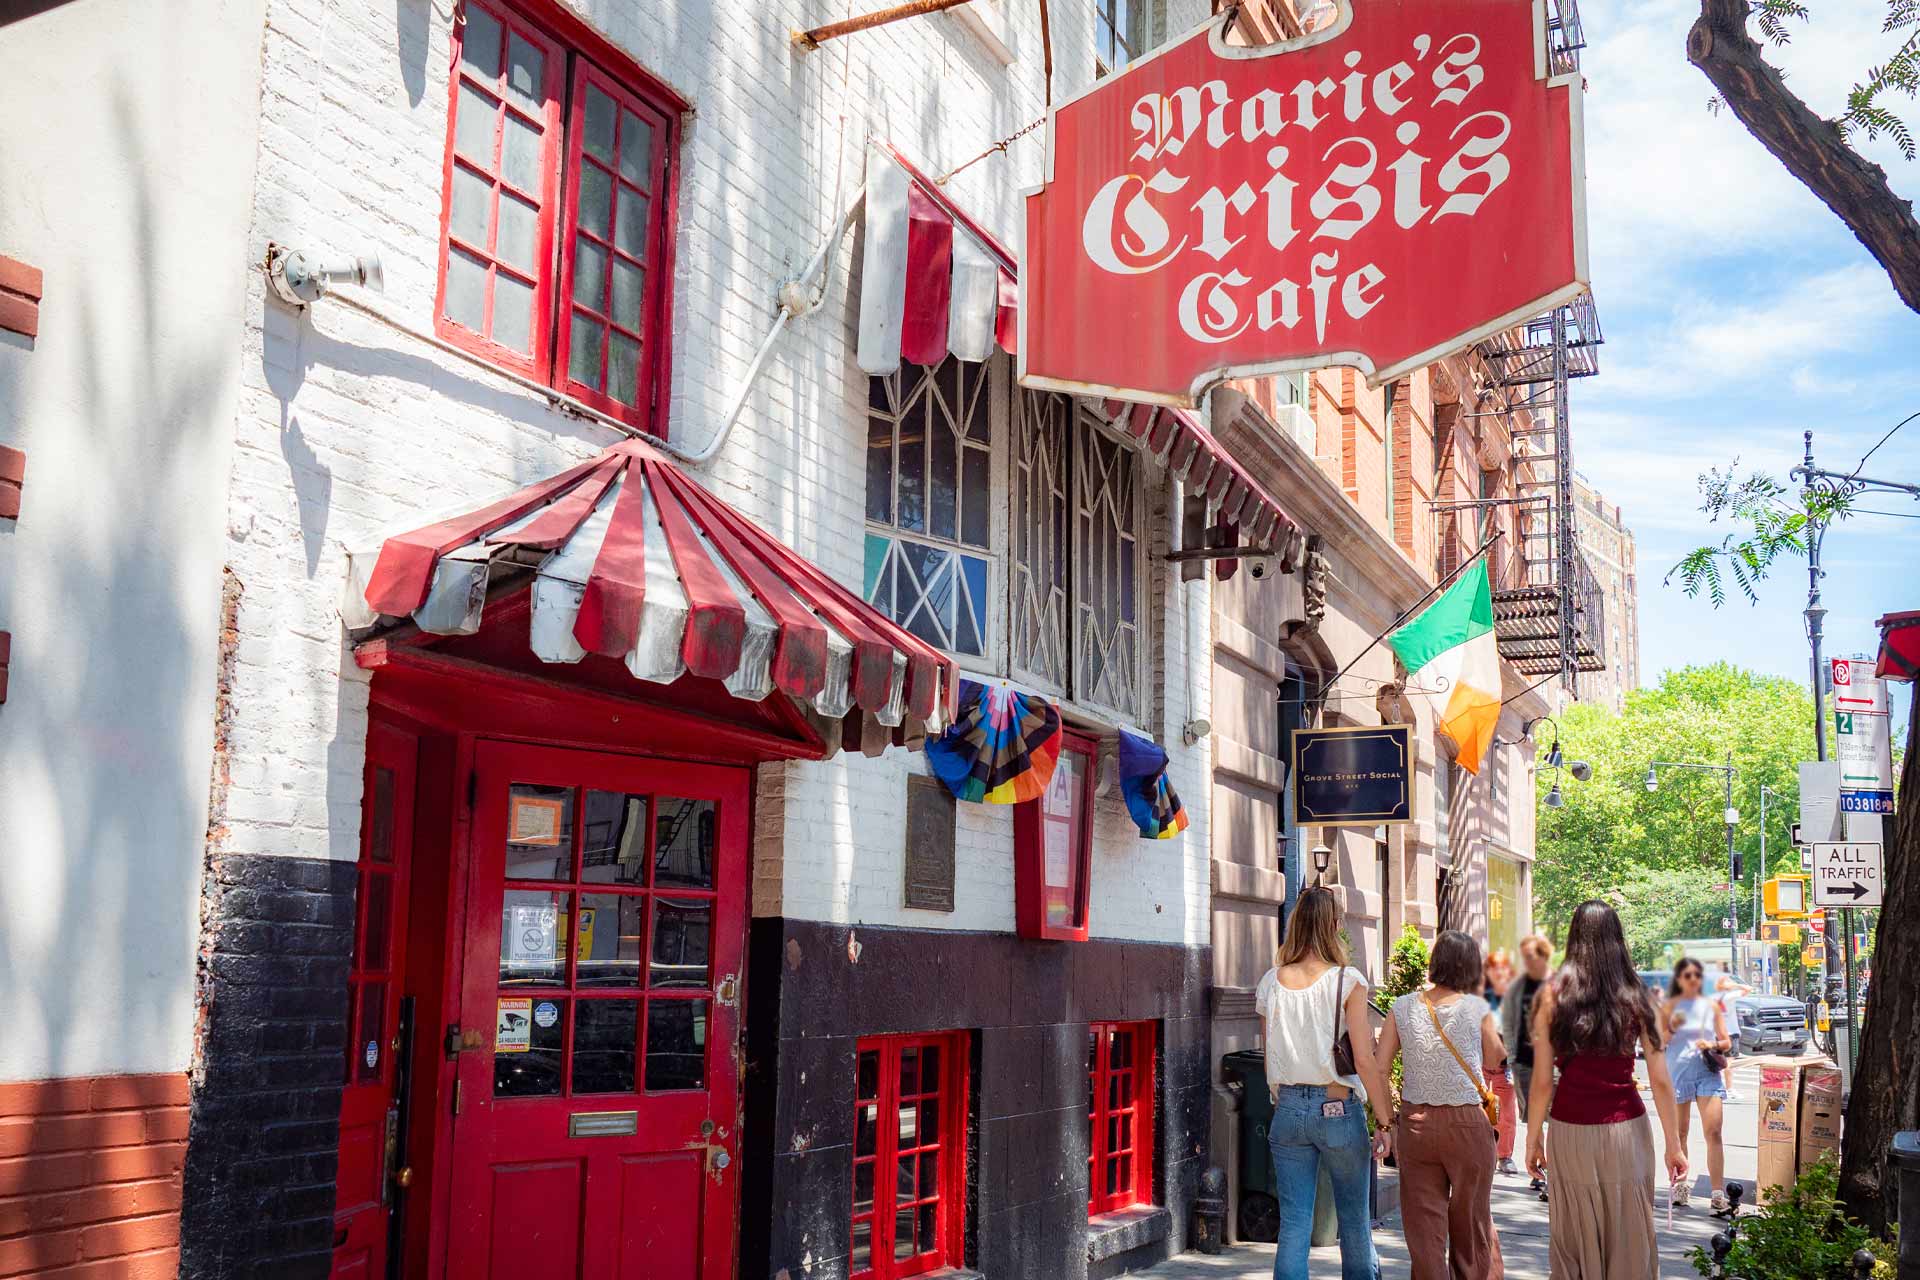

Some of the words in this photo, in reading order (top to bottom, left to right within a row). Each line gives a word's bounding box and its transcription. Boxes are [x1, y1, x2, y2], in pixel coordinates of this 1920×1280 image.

[1129, 33, 1484, 162] Marie's
[1082, 111, 1511, 274] Crisis
[1178, 249, 1385, 345] Cafe
[1840, 713, 1849, 732] 2
[1054, 764, 1068, 800] A
[1841, 797, 1881, 811] 103818
[1829, 847, 1866, 863] ALL
[1820, 867, 1876, 879] TRAFFIC
[500, 1001, 529, 1009] WARNING
[1763, 1090, 1790, 1099] FRAGILE
